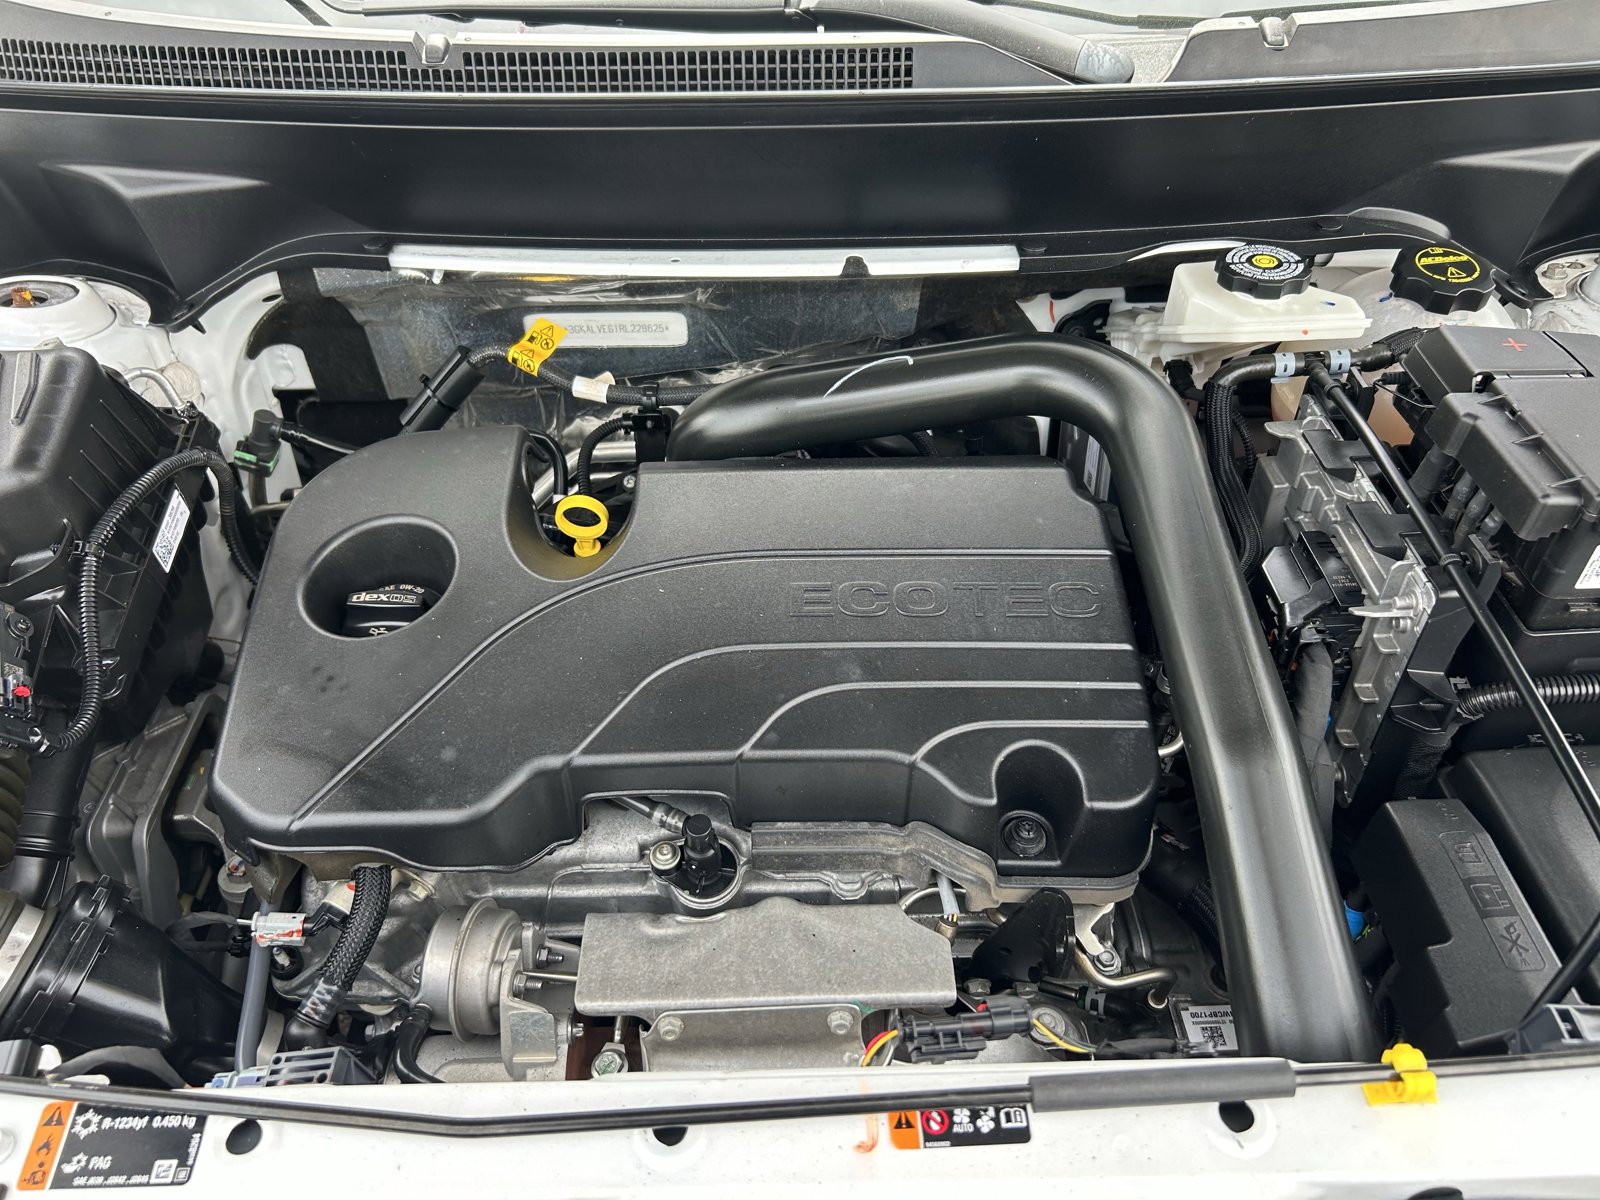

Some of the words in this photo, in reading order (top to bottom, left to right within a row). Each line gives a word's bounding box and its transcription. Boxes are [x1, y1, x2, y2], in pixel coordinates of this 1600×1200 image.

[1420, 256, 1468, 264] ACDelco
[399, 584, 425, 594] 0W-20
[351, 592, 417, 604] dexos
[790, 580, 1101, 618] ECOTEC
[101, 1115, 149, 1131] R-1234yf
[152, 1115, 181, 1128] 0.450
[181, 1115, 197, 1130] kg
[952, 1122, 975, 1133] AUTO
[87, 1156, 112, 1171] PAG
